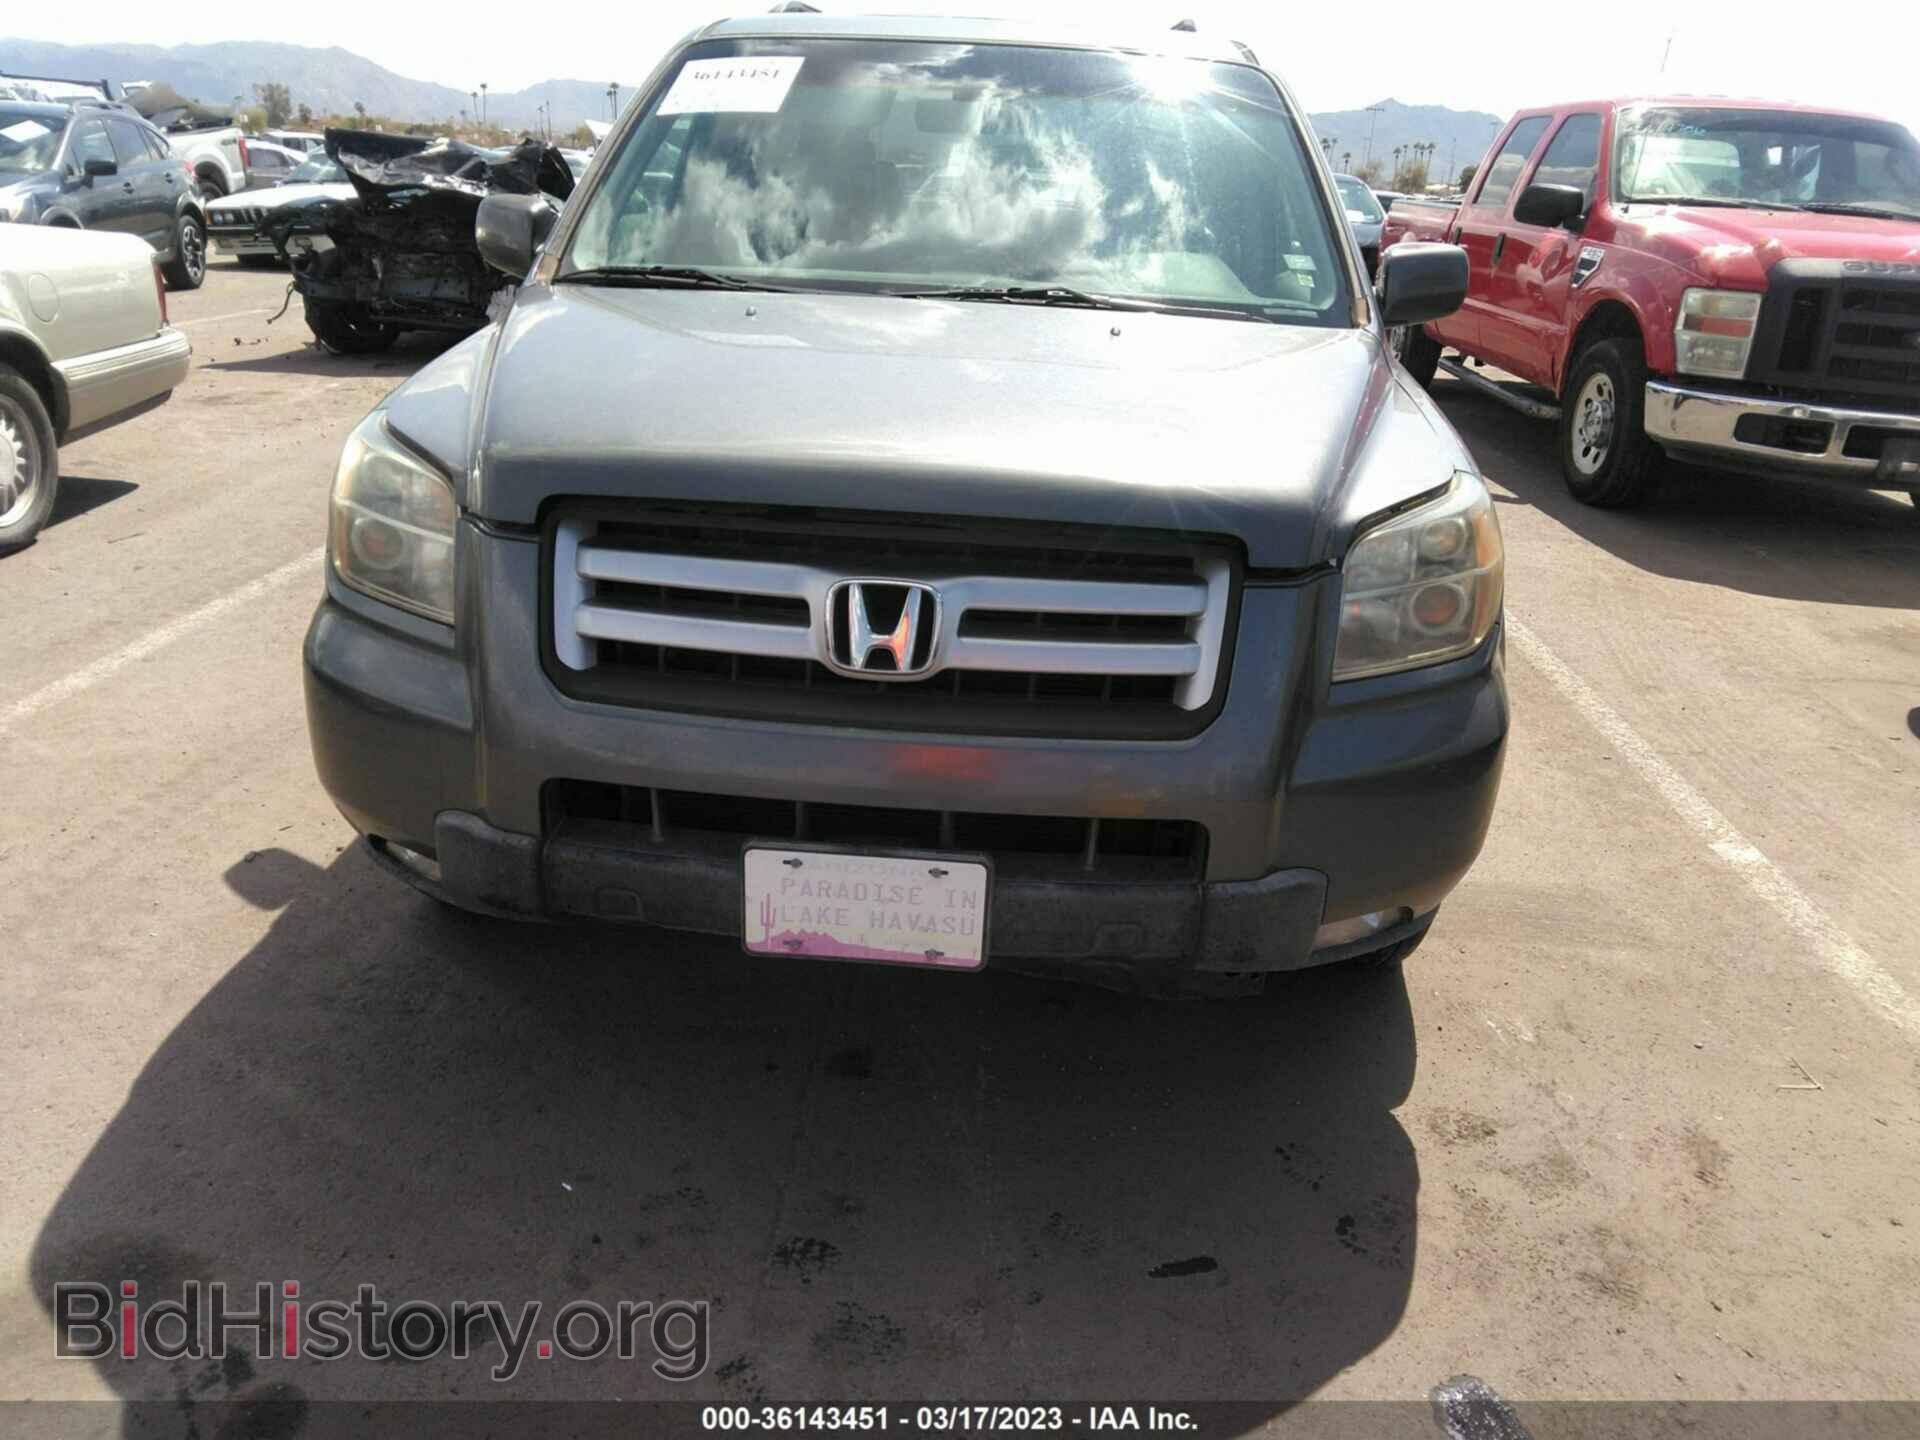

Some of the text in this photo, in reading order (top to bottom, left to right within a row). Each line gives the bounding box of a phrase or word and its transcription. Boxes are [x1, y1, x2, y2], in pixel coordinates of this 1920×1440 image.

[780, 877, 977, 909] PARADISE IN
[780, 904, 975, 936] LAKE HAVASU
